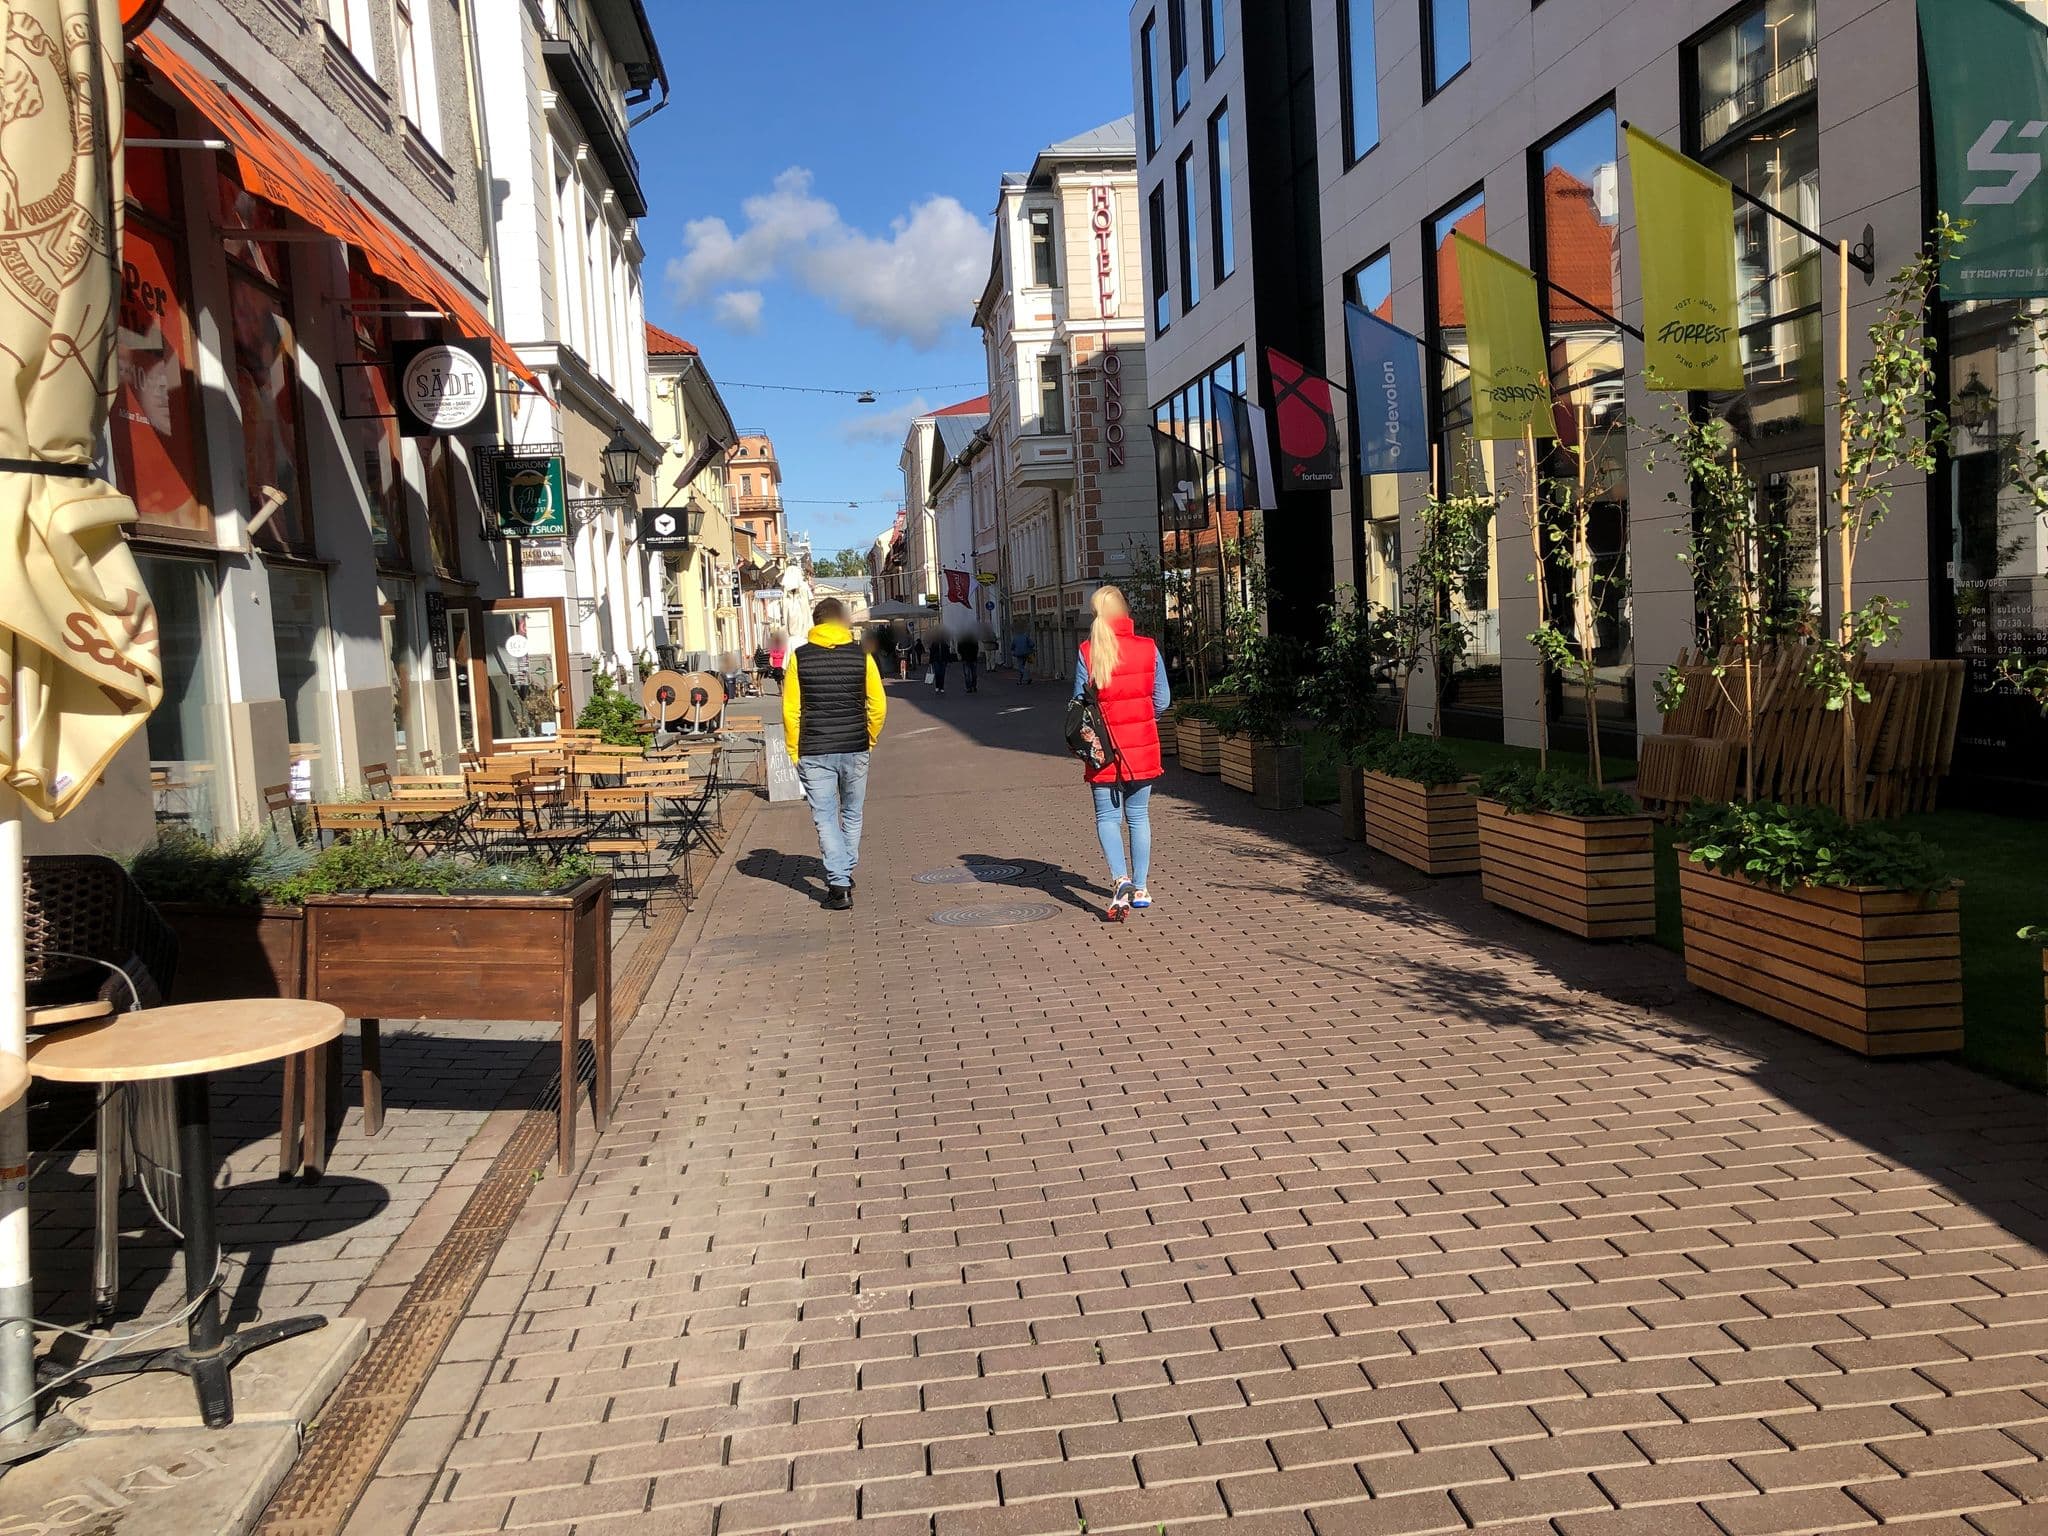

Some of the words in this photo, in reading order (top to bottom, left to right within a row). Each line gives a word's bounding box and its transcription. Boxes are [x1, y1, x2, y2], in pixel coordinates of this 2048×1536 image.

[1091, 185, 1116, 320] HOTELL
[1960, 268, 2034, 280] STAGNATION
[1674, 297, 1691, 312] TOIT
[1699, 299, 1717, 313] JOOK
[1657, 320, 1732, 345] FORREST
[1675, 353, 1693, 368] PING
[416, 369, 476, 398] SÄDE
[1102, 330, 1125, 468] LONDON
[1302, 471, 1333, 481] fortumo
[502, 526, 534, 536] BEAUTY
[535, 524, 564, 534] SALON
[1972, 606, 1986, 615] Mon
[1972, 619, 1986, 628] Tue
[1972, 633, 1987, 642] Wed
[1997, 632, 2047, 641] 07:30...02
[1972, 645, 1987, 654] Thu
